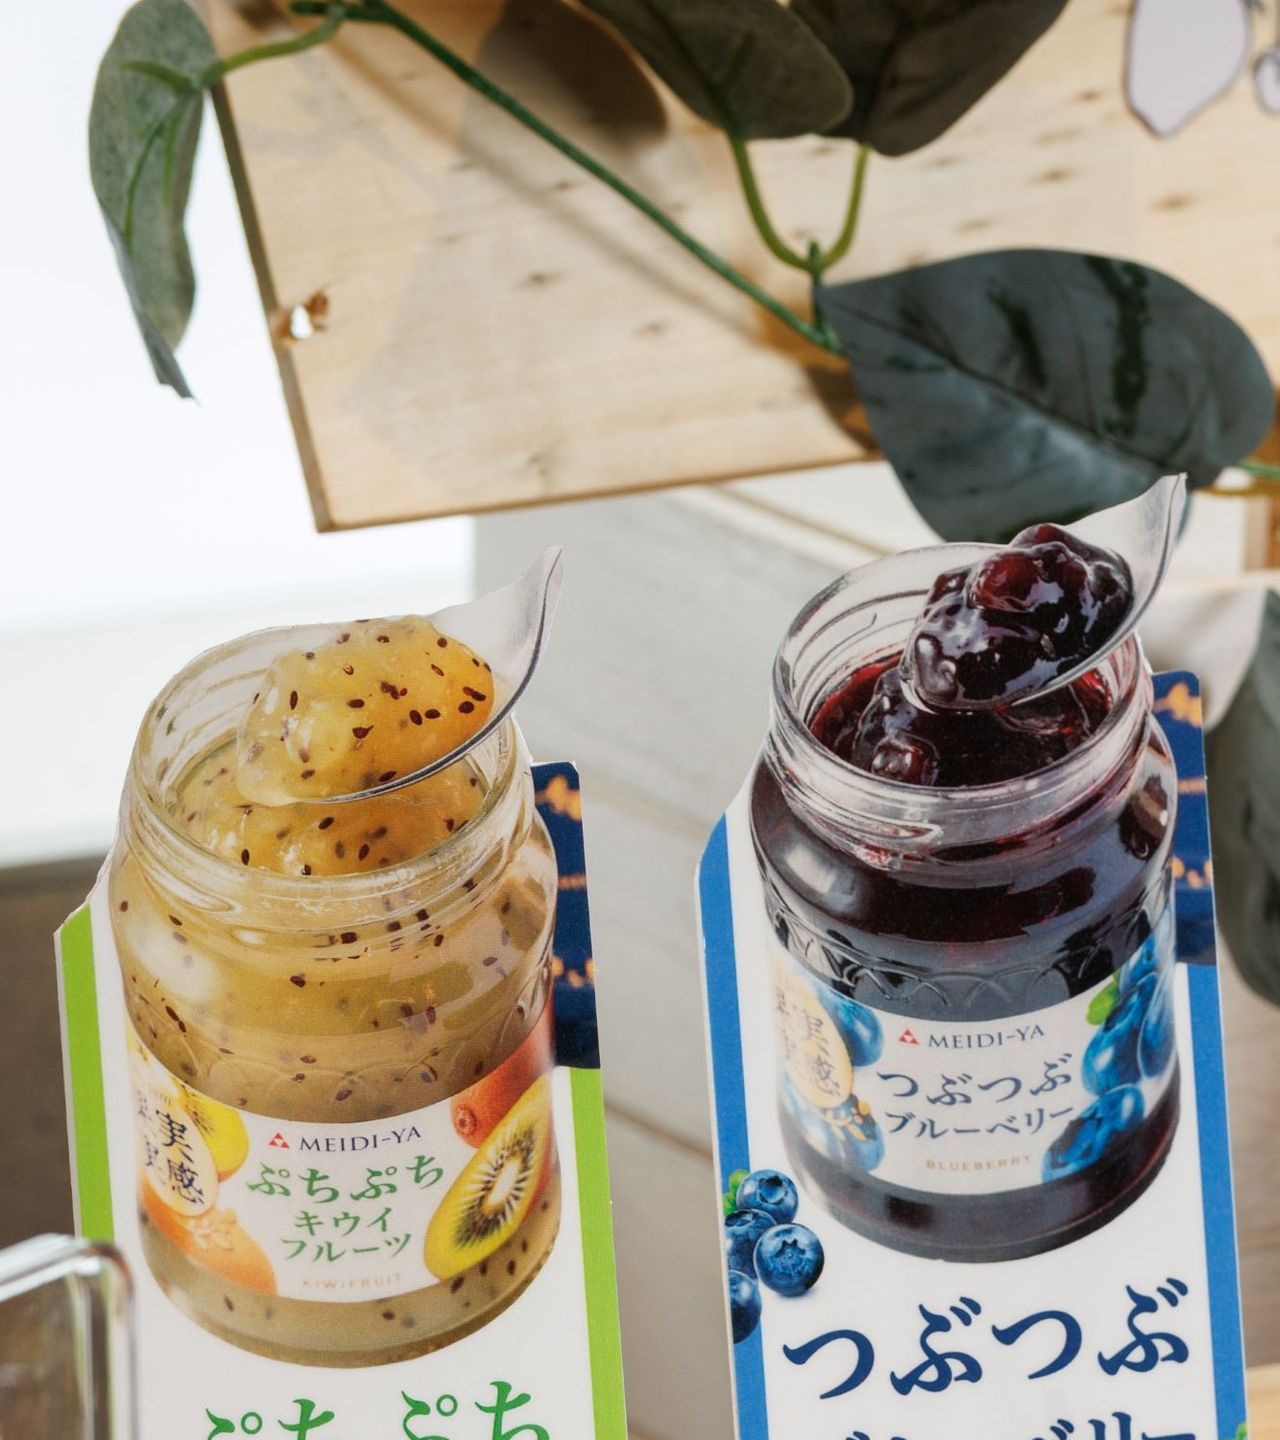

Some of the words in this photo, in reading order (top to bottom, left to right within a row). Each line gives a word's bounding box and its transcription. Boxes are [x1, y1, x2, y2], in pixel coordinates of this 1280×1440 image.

[928, 1024, 1046, 1050] MEIDI-YA
[877, 1052, 1073, 1107] つぶつぶ
[885, 1104, 1077, 1140] ブルーベリー
[300, 1125, 422, 1154] MEIDI-YA
[925, 1153, 1032, 1171] BLUEBERRY
[247, 1154, 445, 1204] ぷちぷち
[293, 1207, 394, 1237] キウイ
[281, 1233, 413, 1264] フルーツ
[782, 1277, 1190, 1400] つぶつぶ
